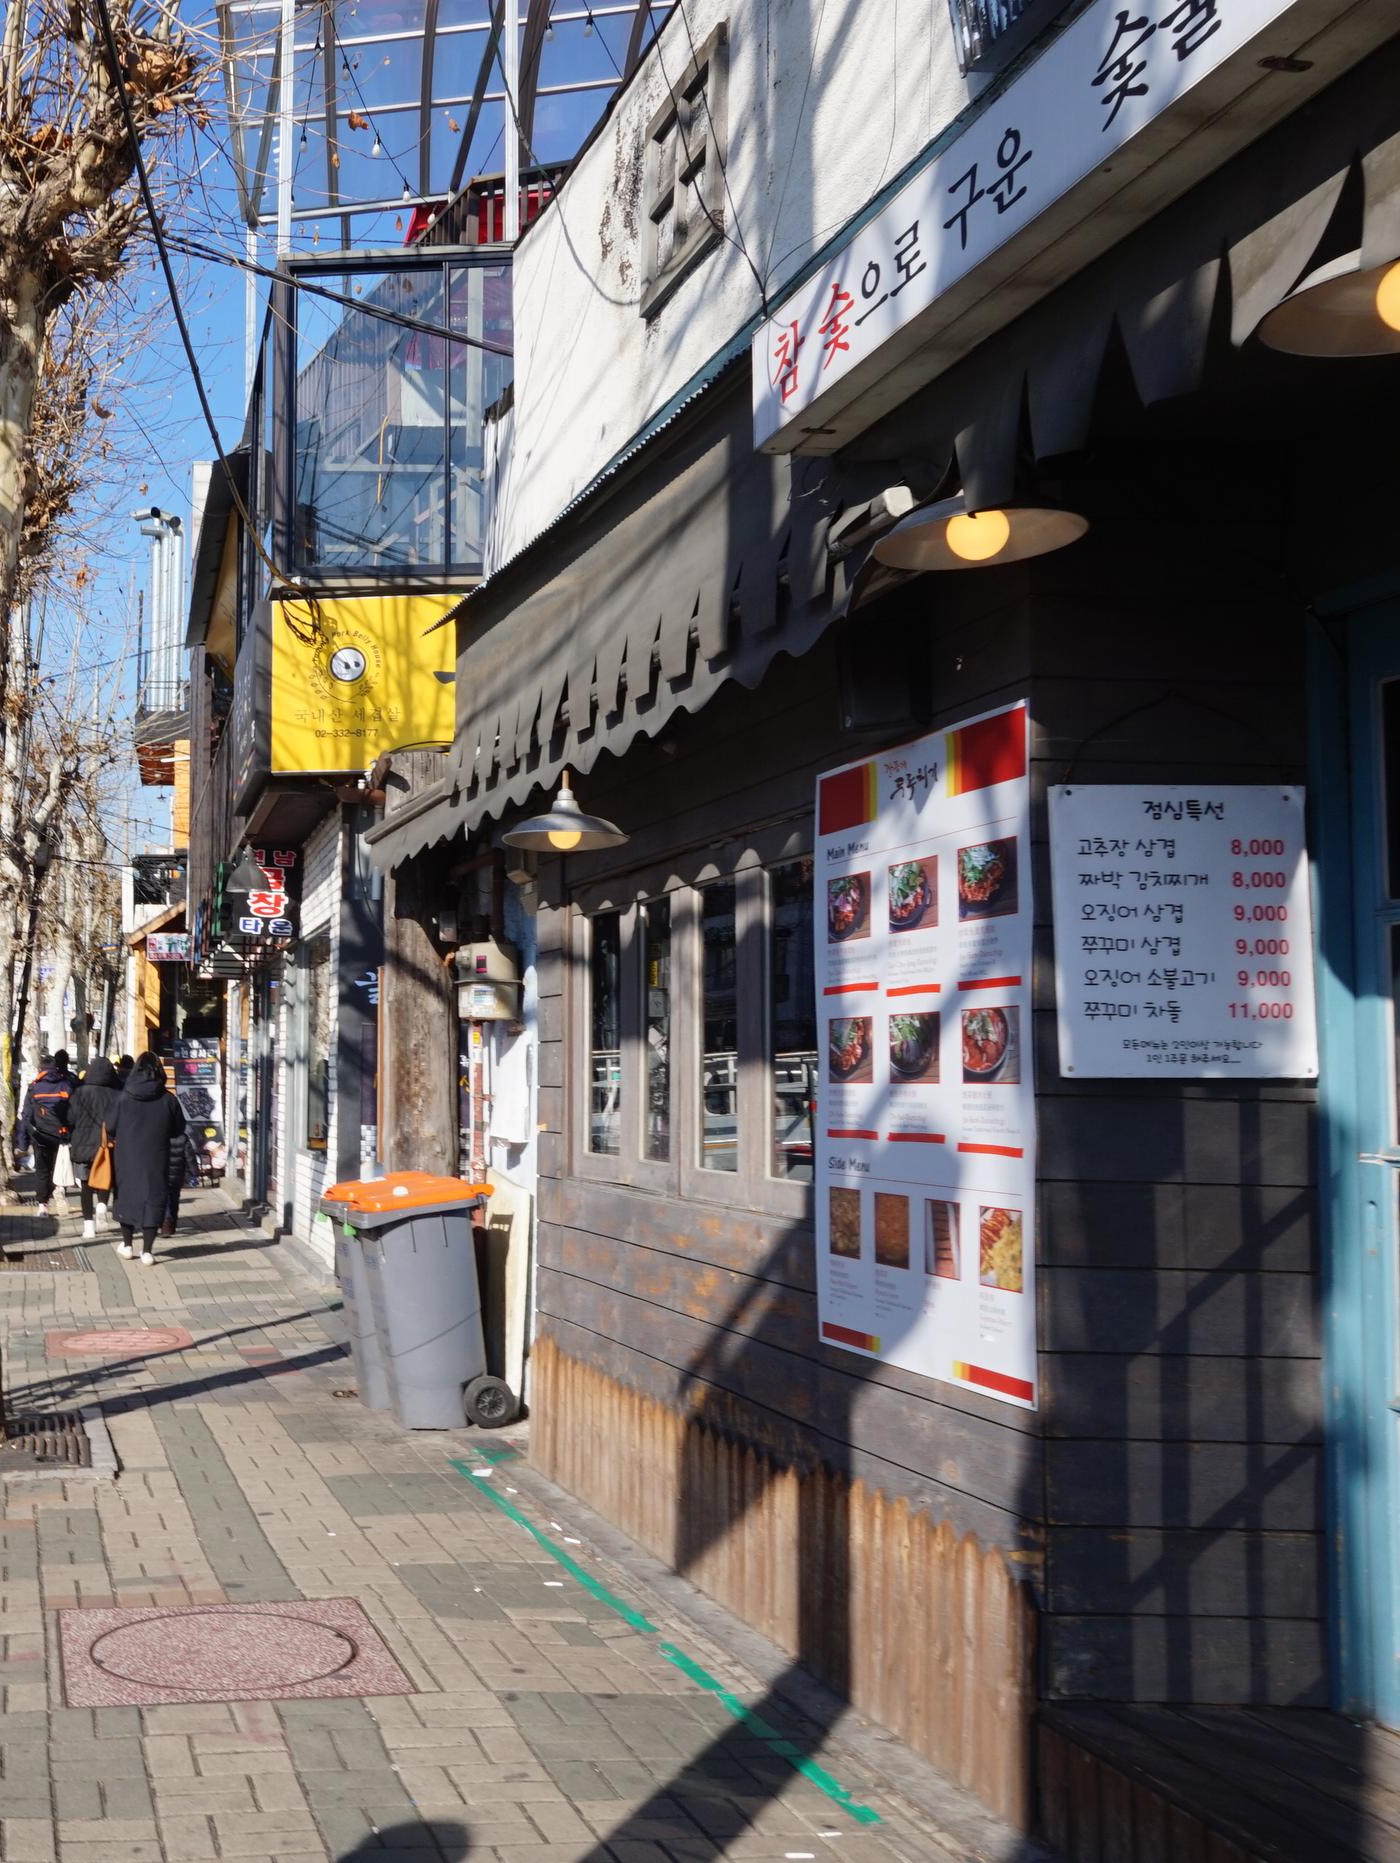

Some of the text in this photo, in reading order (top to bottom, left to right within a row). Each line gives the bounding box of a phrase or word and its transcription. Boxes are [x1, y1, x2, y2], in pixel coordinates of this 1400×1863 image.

[773, 221, 927, 403] 참숯으로
[943, 127, 1033, 249] 구운
[295, 708, 344, 724] 국내산
[315, 729, 379, 738] 02-332-8177
[1142, 799, 1225, 821] 점심특선
[826, 846, 845, 862] Main
[1077, 837, 1285, 859] 고추장 삼겹 8,000
[1078, 870, 1287, 891] 짜박 김치찌개 8,000
[1081, 903, 1288, 924] 오징어 삼겹 9,000
[239, 916, 293, 937] 타운
[1080, 935, 1290, 957] 쭈꾸미 삼겹 9,000
[1083, 967, 1292, 990] 오징어 소불고기 9,000
[1083, 1000, 1294, 1024] 쭈꾸미 차돌 11,000
[827, 1155, 871, 1173] Side Menu
